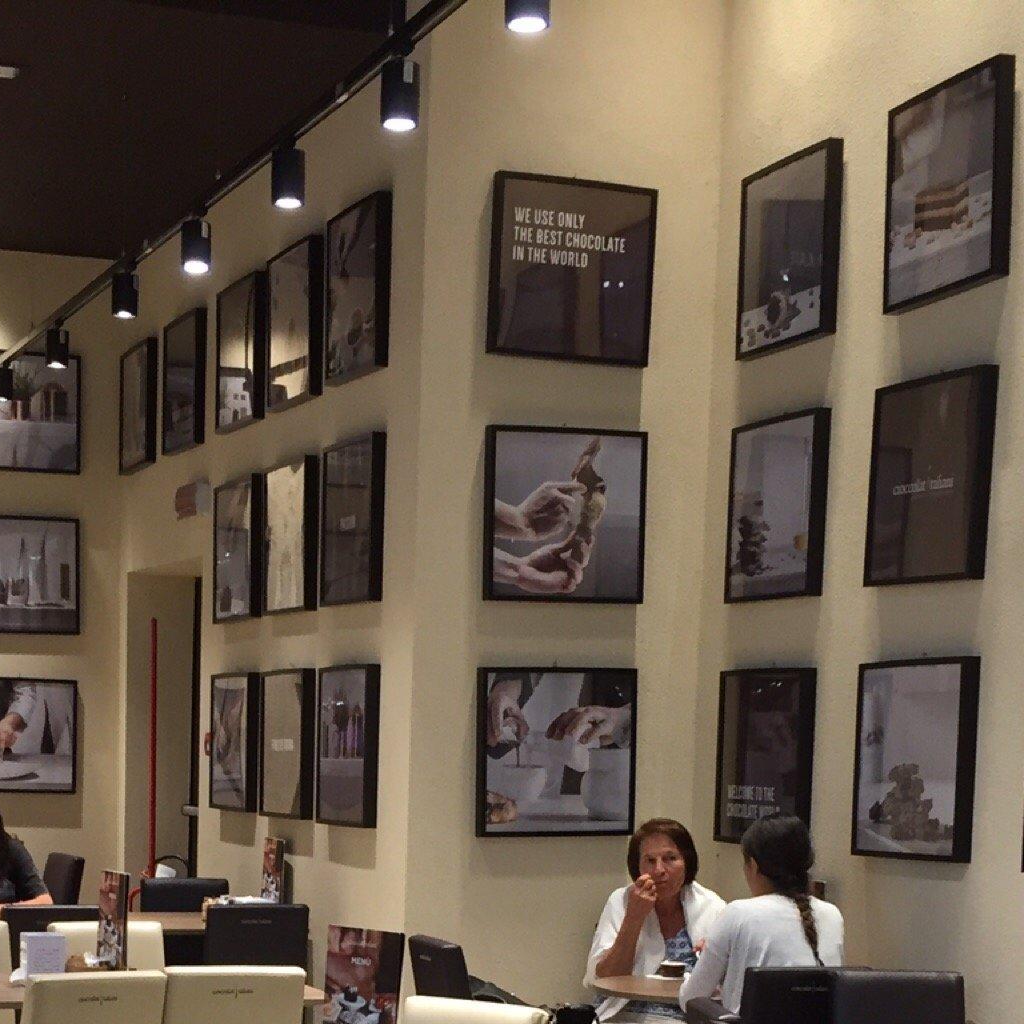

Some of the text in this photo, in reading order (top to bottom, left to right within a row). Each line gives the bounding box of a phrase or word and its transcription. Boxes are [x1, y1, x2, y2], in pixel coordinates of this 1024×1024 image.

[514, 206, 586, 230] WE USE ONLY
[513, 226, 626, 254] THE BEST CHOCOLATE
[512, 244, 589, 269] IN THE WORLD
